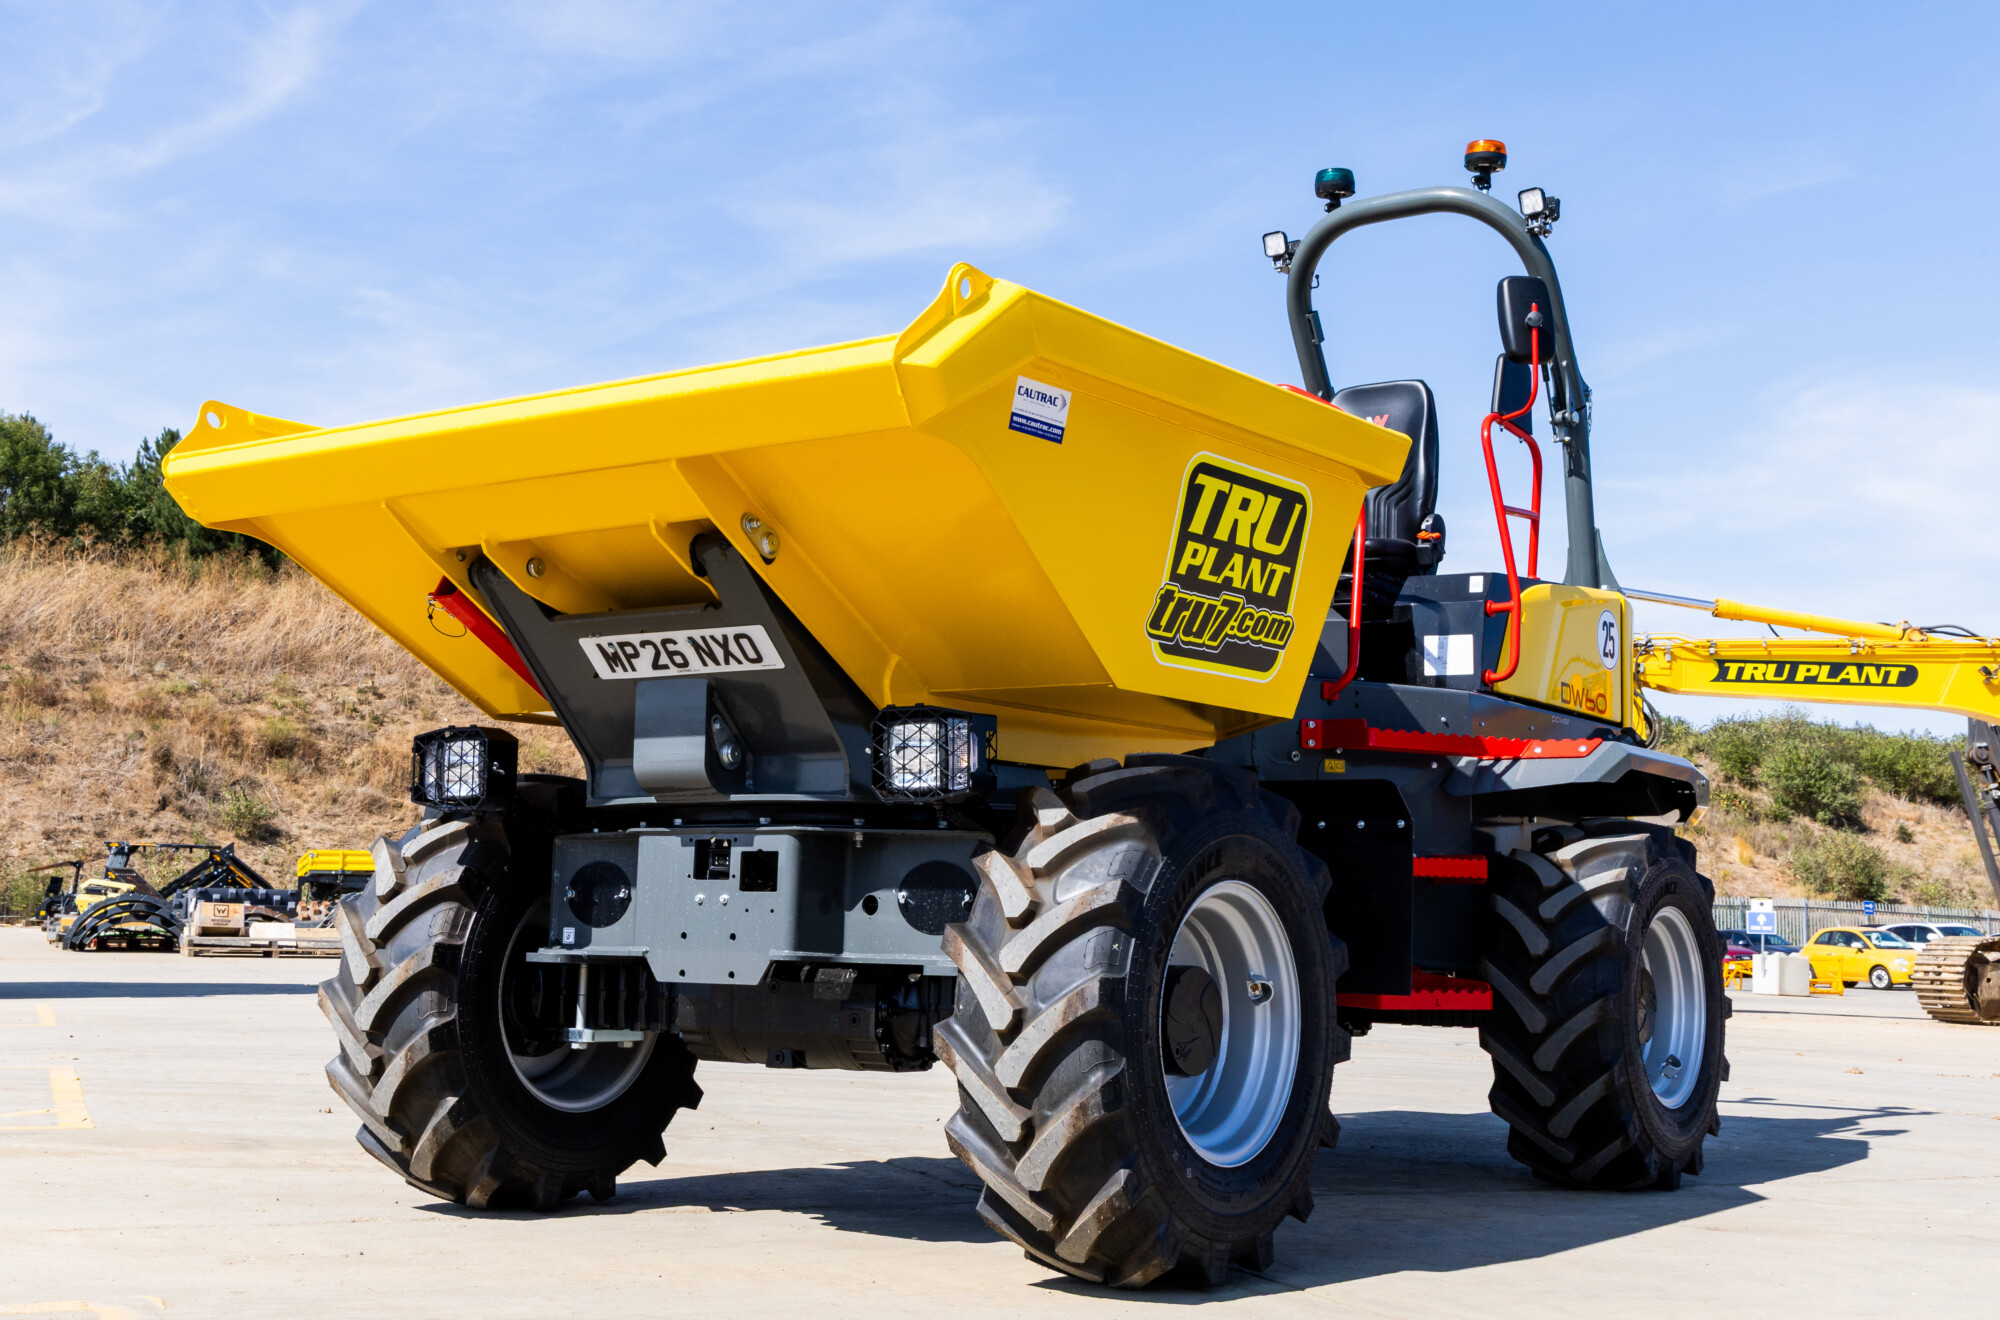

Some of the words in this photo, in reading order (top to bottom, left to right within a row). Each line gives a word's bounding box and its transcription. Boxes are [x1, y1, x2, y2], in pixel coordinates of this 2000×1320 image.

[1017, 385, 1060, 407] CAUTRAC
[1012, 415, 1062, 436] www.cautrac.com
[1187, 472, 1304, 556] TRU
[1176, 540, 1291, 598] PLANT
[1148, 584, 1295, 647] tru7.com
[595, 637, 690, 673] MP26
[687, 632, 764, 668] NXO
[1602, 620, 1615, 660] 25
[1724, 662, 1791, 682] TRU
[1794, 664, 1907, 685] PLANT
[1560, 681, 1608, 715] DW60
[1161, 847, 1224, 948] ALLIANCE
